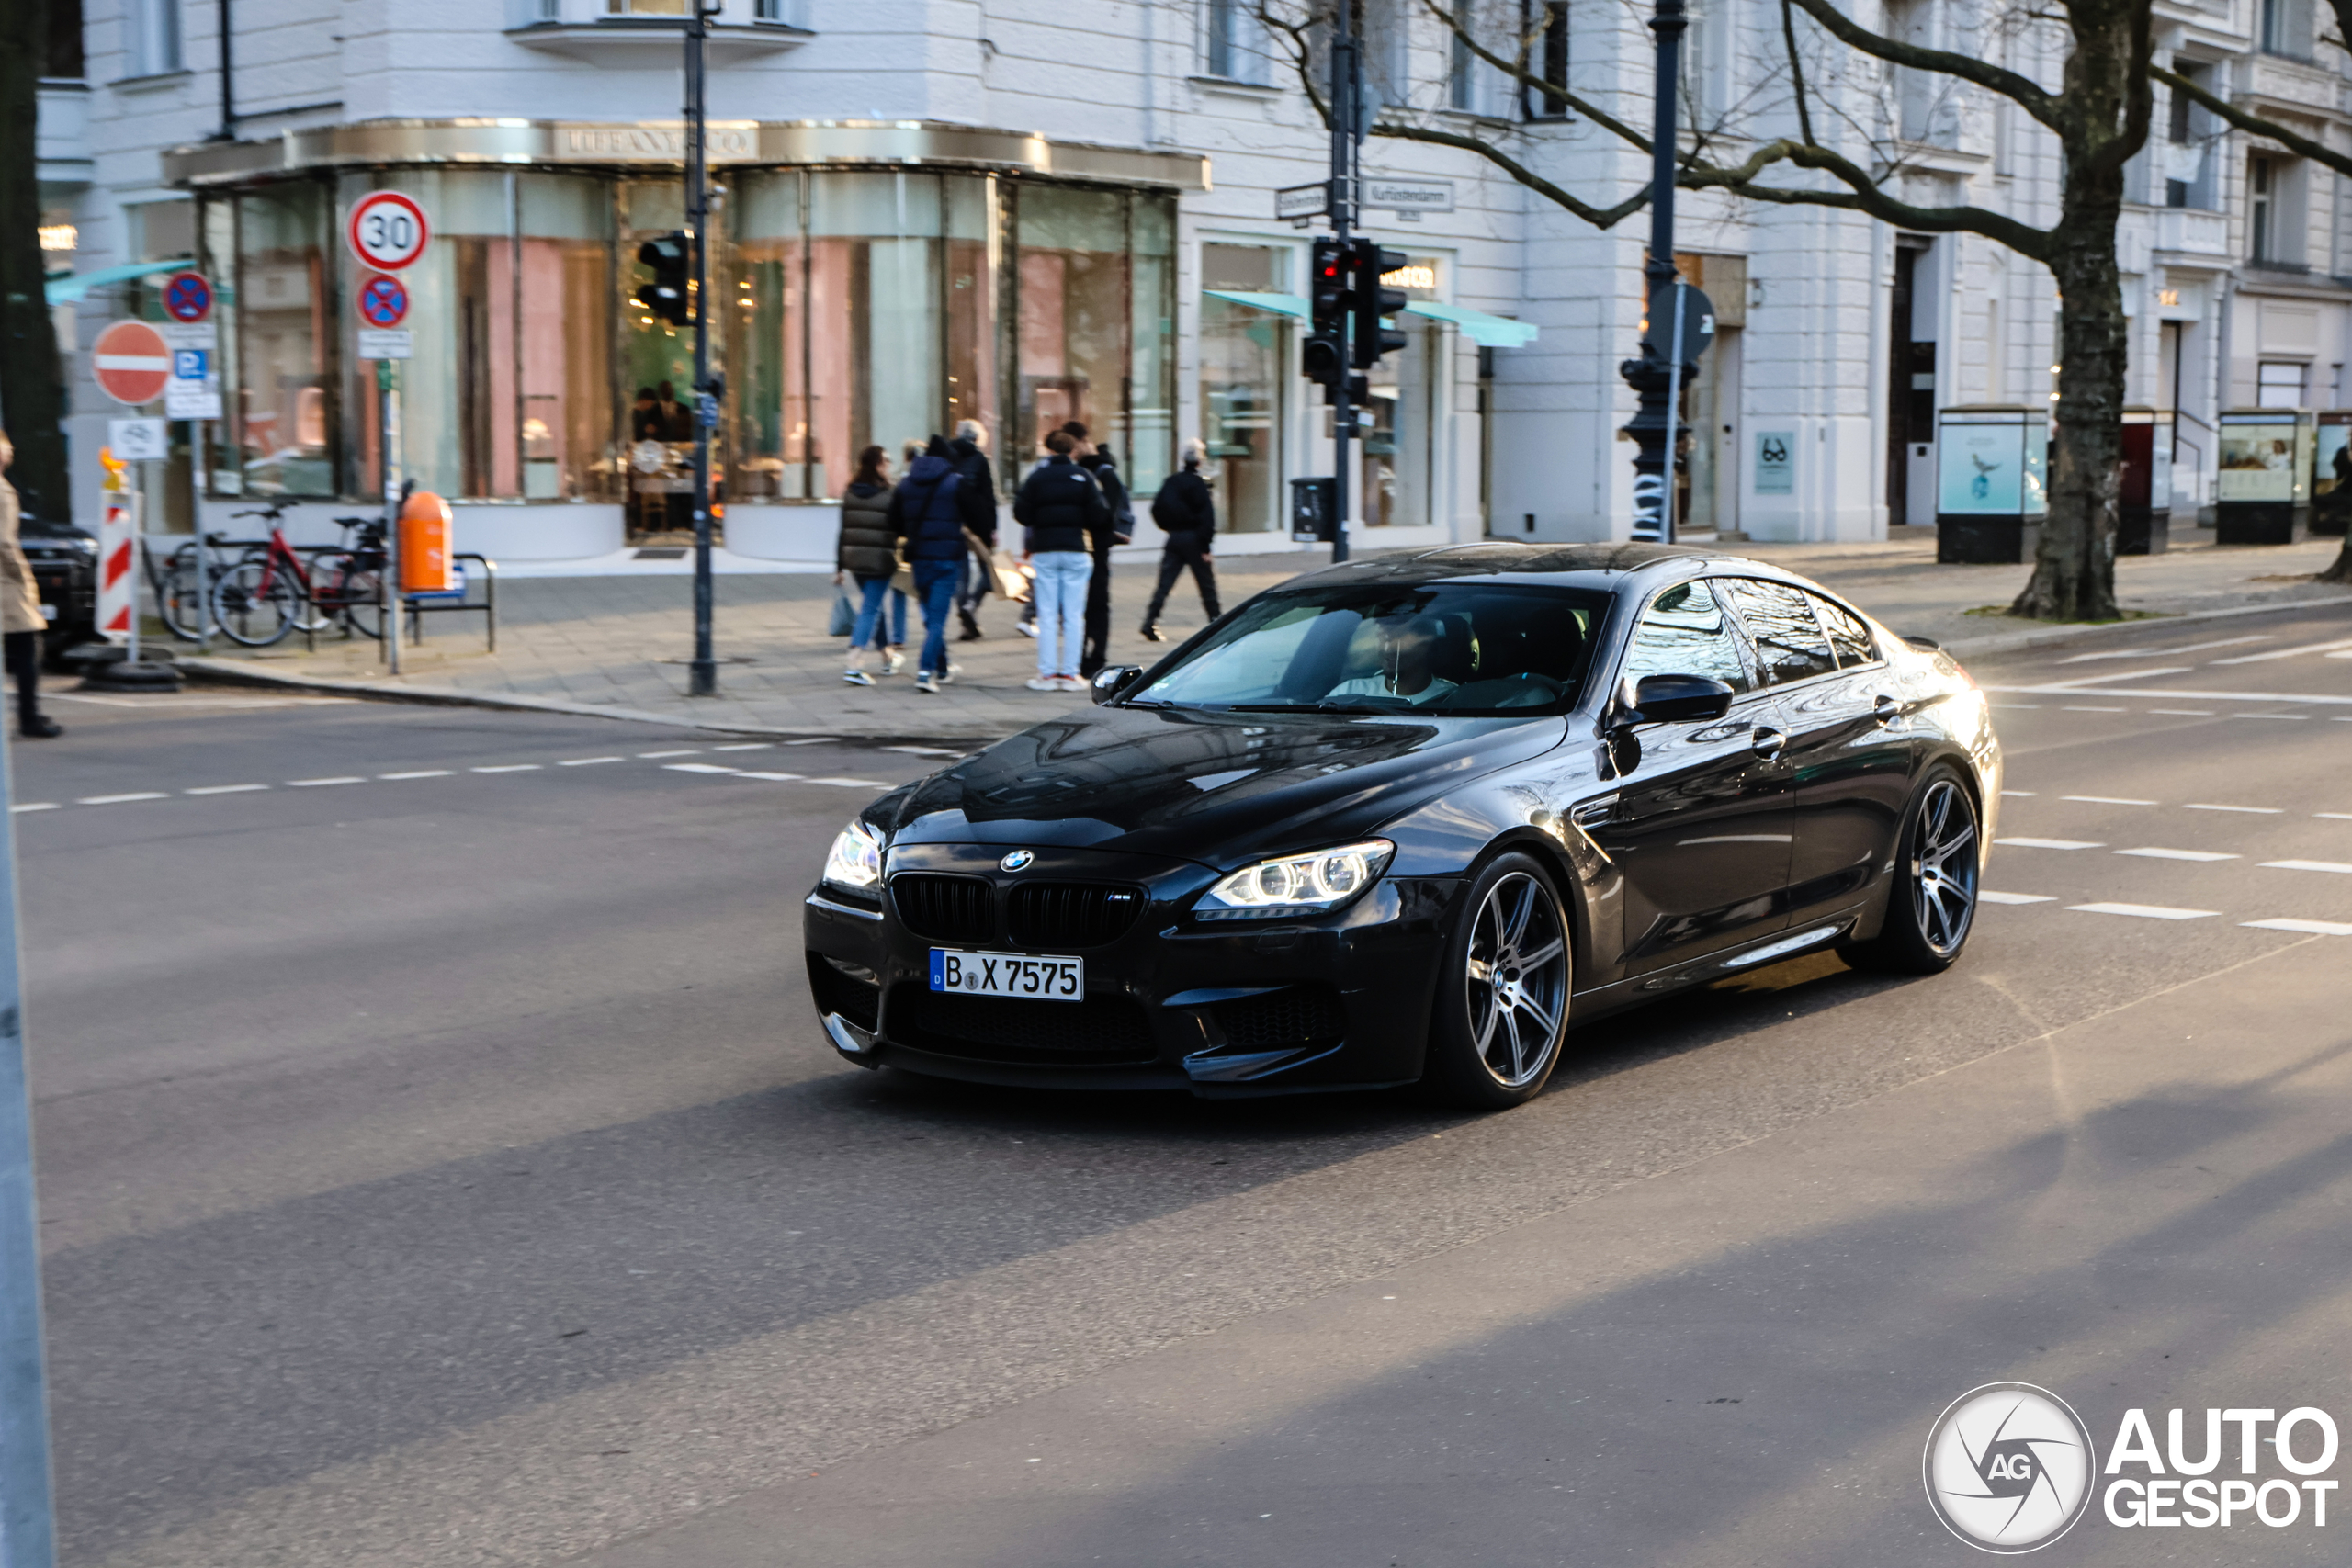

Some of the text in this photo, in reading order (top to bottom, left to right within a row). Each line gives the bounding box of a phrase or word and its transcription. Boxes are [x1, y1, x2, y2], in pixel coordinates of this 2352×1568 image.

[367, 215, 412, 249] 30
[934, 956, 1077, 995] D B X 7575
